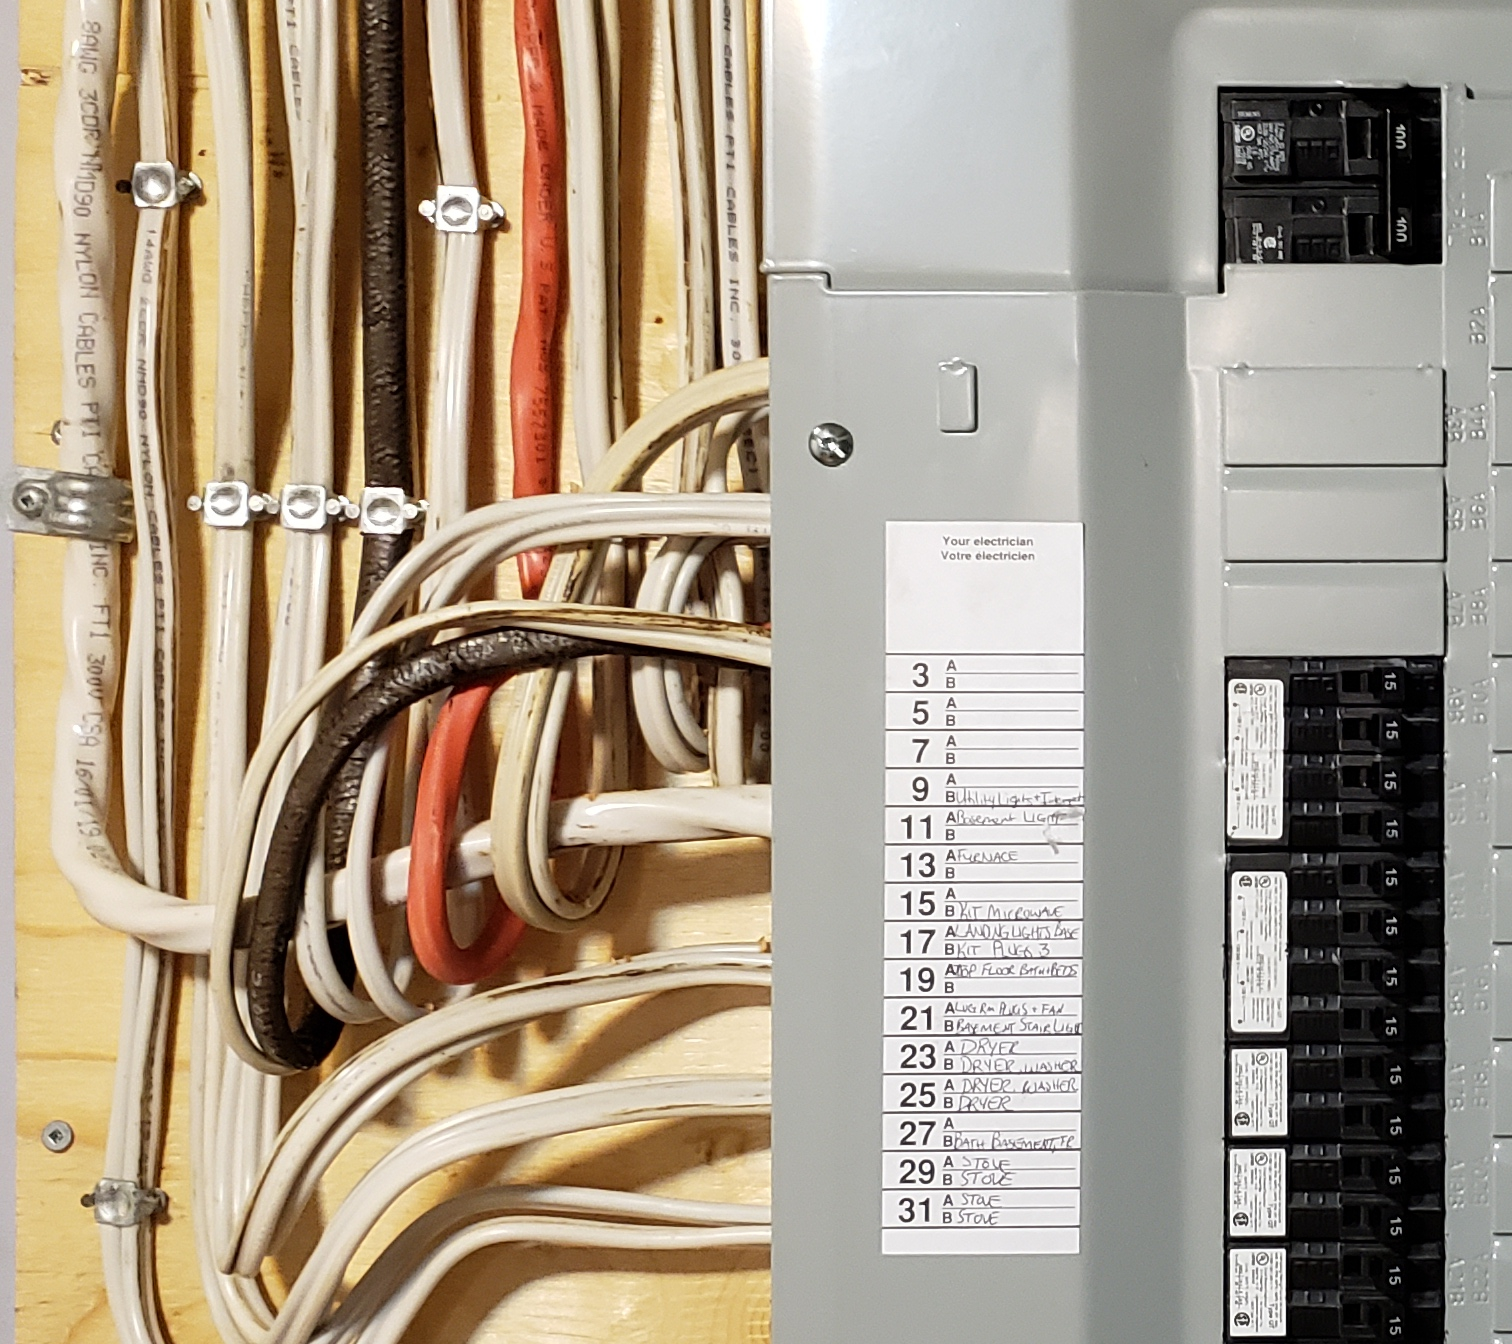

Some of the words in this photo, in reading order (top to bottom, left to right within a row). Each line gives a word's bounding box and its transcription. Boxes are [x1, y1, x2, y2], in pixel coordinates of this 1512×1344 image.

[79, 21, 101, 74] 8AWG
[79, 89, 100, 139] 3CDR
[1396, 124, 1406, 149] 100
[73, 151, 101, 217] NMD90
[1397, 217, 1407, 242] 100
[76, 233, 99, 299] NYLON
[75, 312, 100, 388] CABLES
[943, 536, 970, 546] Your
[974, 537, 1033, 546] electrician
[90, 543, 108, 587] INC.
[941, 551, 971, 560] Votre
[975, 551, 1034, 561] électricien
[90, 604, 109, 638] FT1
[88, 653, 106, 700] 300V
[913, 663, 929, 687] 3
[1385, 673, 1396, 690] 15
[913, 701, 929, 725] 5
[79, 712, 103, 747] CSA
[912, 739, 929, 763] 7
[913, 777, 928, 801] 9
[1385, 772, 1396, 789] 15
[901, 815, 931, 839] 11
[901, 853, 935, 877] 13
[901, 891, 935, 916] 15
[1386, 917, 1397, 935] 15
[901, 930, 935, 954] 17
[900, 967, 934, 992] 19
[901, 1006, 931, 1030] 21
[901, 1044, 936, 1069] 23
[1390, 1066, 1401, 1084] 15
[900, 1083, 935, 1107] 25
[900, 1121, 936, 1145] 27
[900, 1159, 935, 1184] 29
[899, 1198, 929, 1223] 31
[1389, 1267, 1401, 1285] 15
